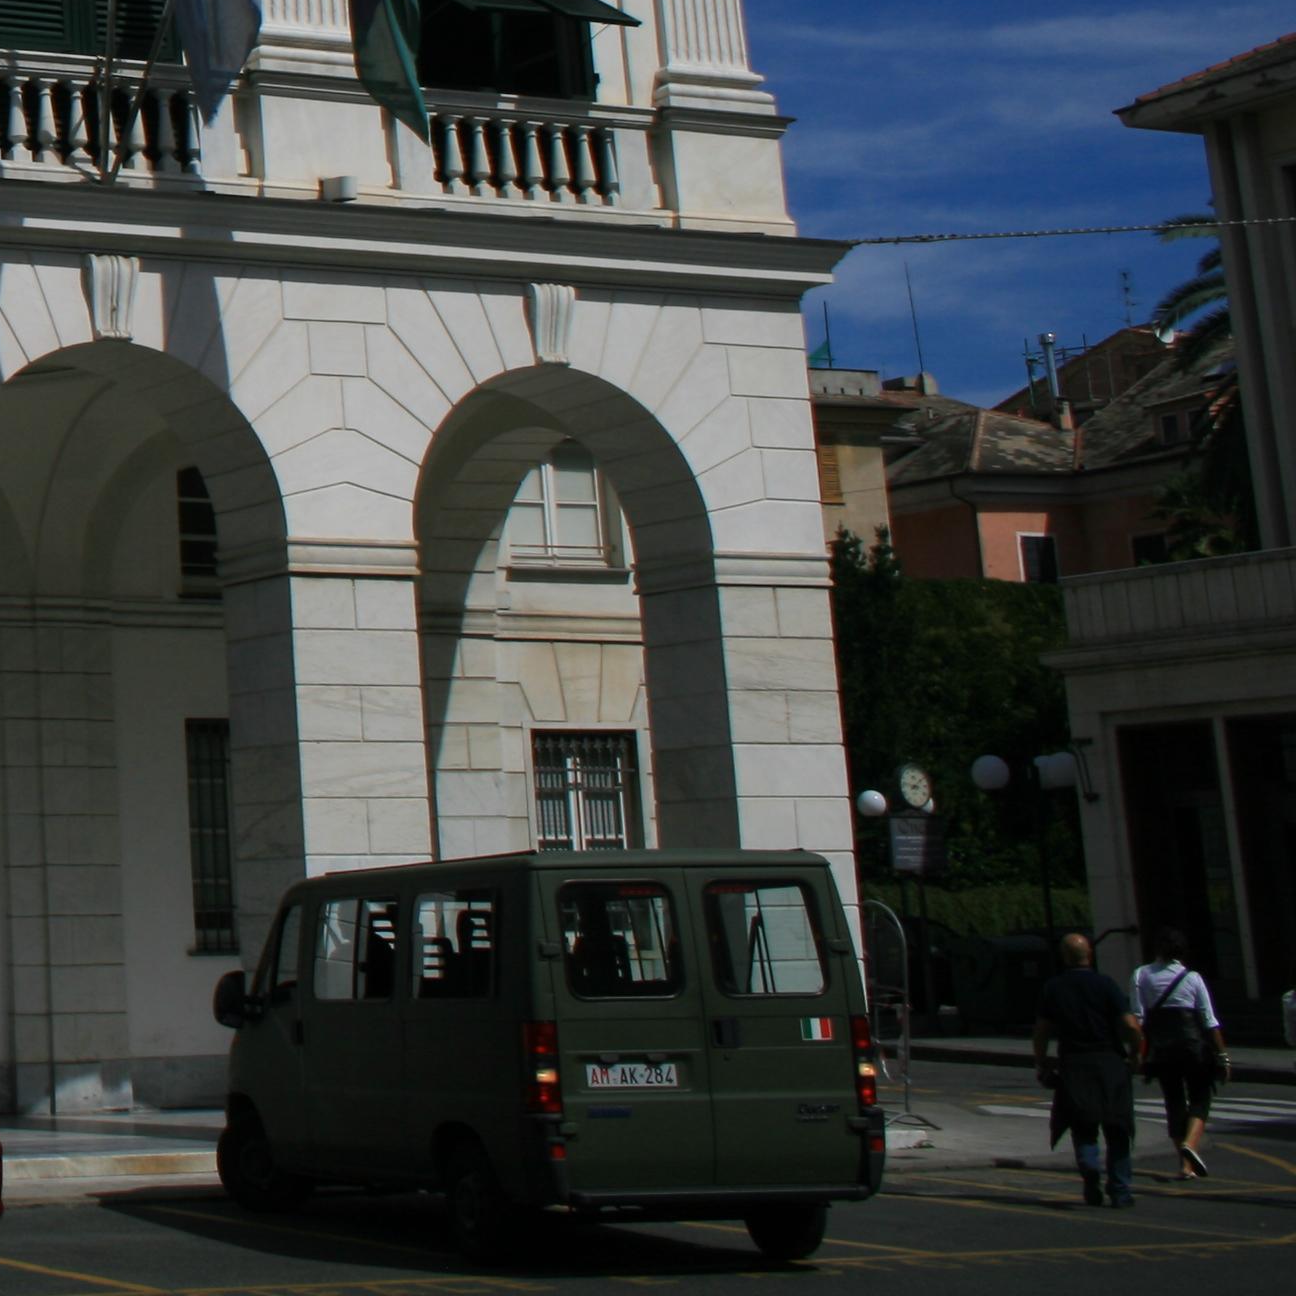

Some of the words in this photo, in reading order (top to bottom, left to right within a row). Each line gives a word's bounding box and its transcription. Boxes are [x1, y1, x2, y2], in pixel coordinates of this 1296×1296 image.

[591, 1066, 610, 1085] AM
[620, 1066, 638, 1085] AK
[644, 1066, 674, 1084] 284
